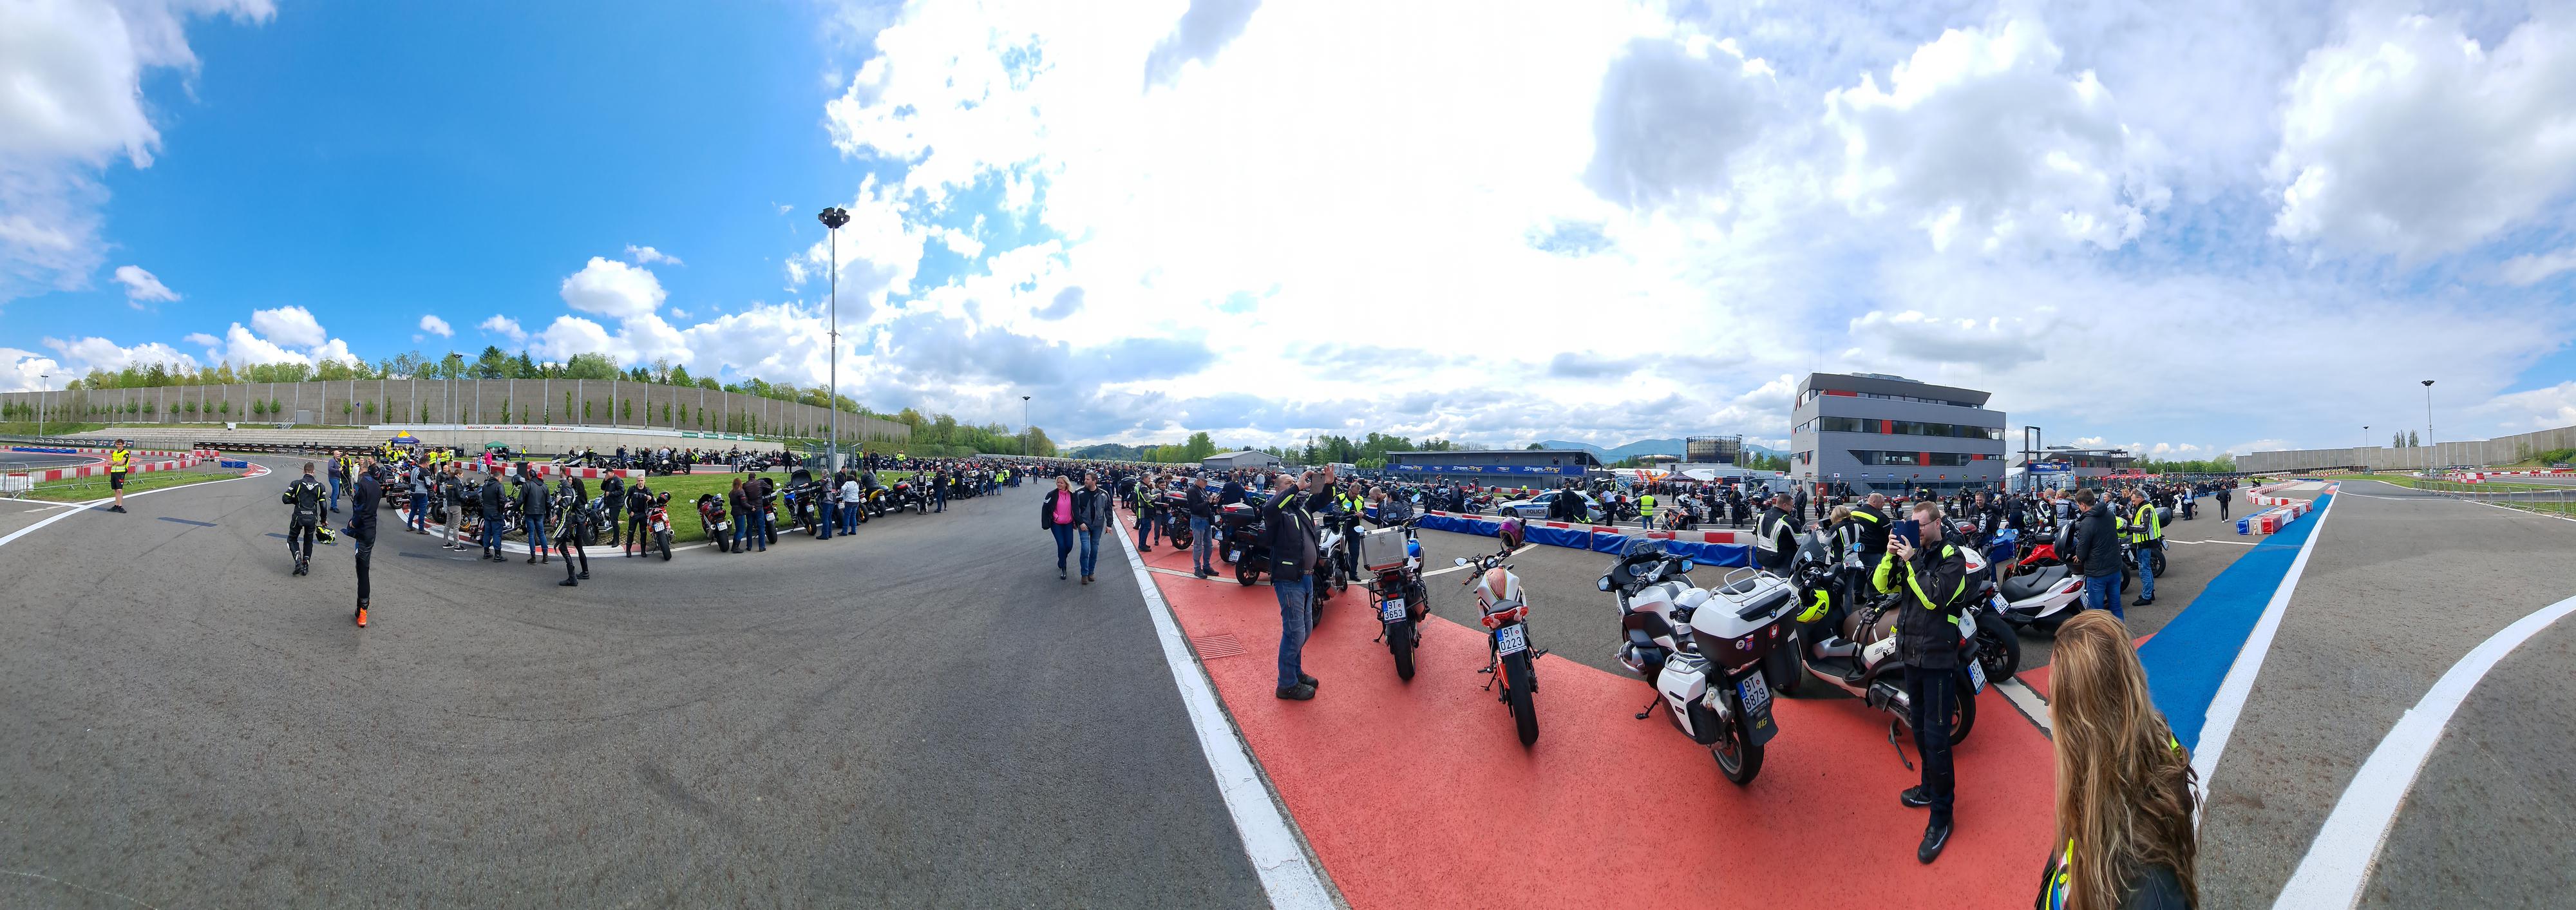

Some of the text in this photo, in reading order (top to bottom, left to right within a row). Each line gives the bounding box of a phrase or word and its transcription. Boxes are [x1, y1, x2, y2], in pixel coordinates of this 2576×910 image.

[1388, 601, 1396, 609] 9T
[1385, 609, 1403, 619] 3653
[1504, 627, 1513, 638] 9T
[1501, 637, 1522, 650] 0223
[1971, 663, 1977, 674] 8T
[1745, 677, 1755, 692] 9T
[1745, 687, 1765, 709] 8879
[1756, 717, 1767, 730] 46
